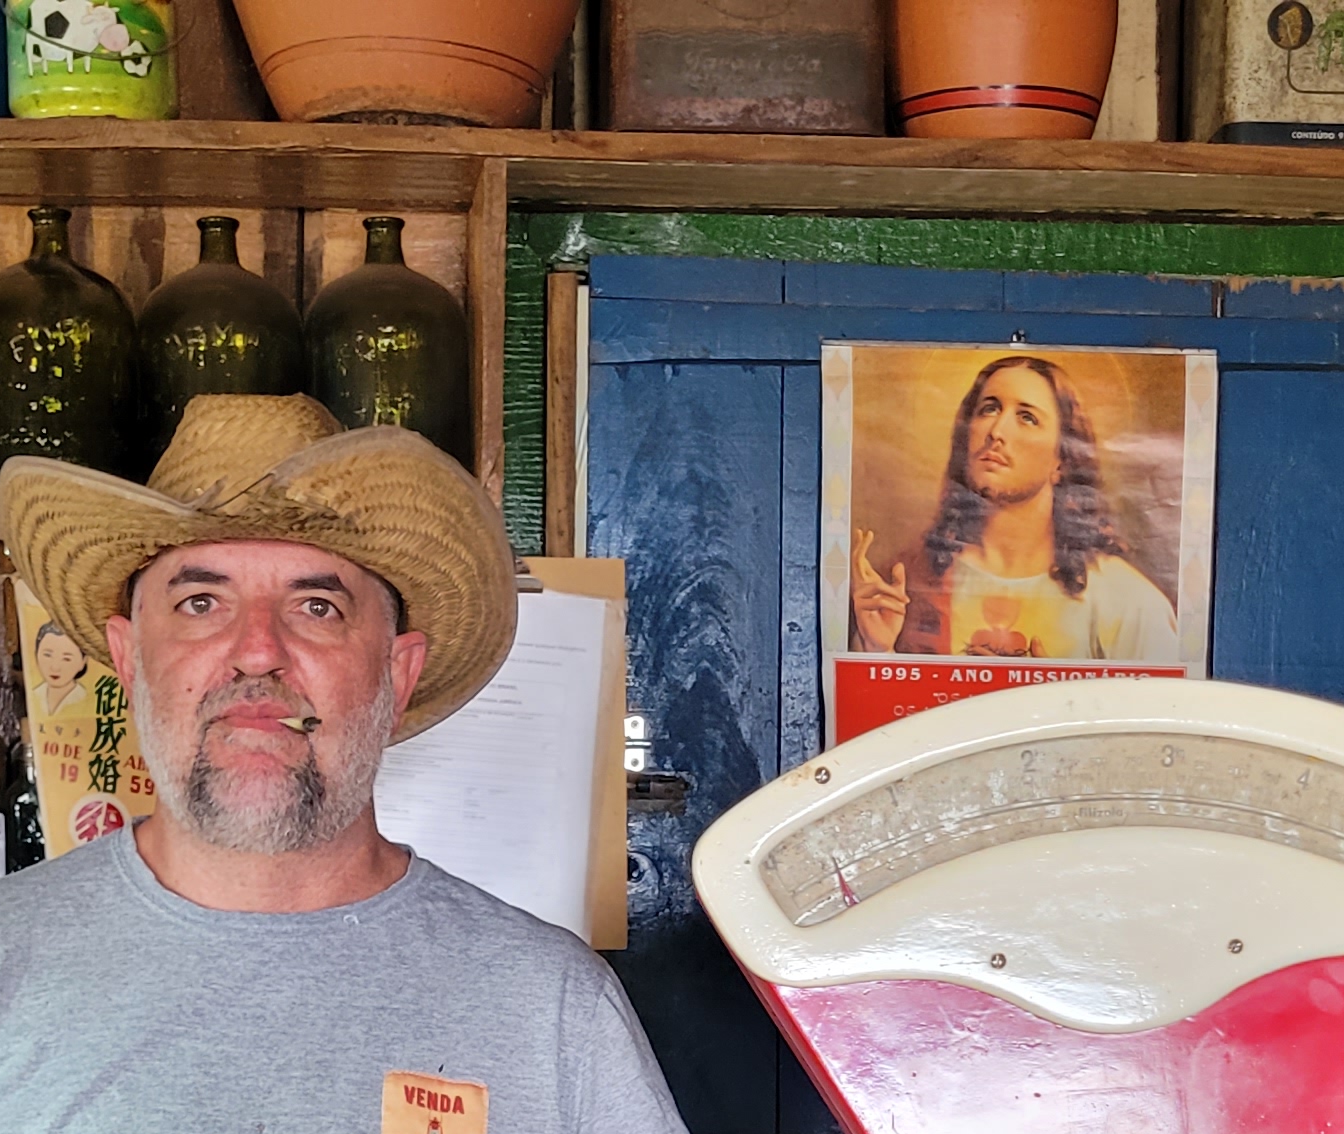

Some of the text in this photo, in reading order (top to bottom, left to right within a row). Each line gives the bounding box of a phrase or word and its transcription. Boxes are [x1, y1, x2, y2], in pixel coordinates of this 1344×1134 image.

[1291, 129, 1335, 141] CONTEÚDO
[1337, 131, 1344, 140] 9
[869, 666, 921, 681] 1995
[950, 668, 994, 683] ANO
[43, 741, 149, 772] 10 DE AB
[60, 763, 155, 796] 19 59
[1078, 806, 1124, 822] Filizola
[404, 1085, 465, 1115] VENDA
